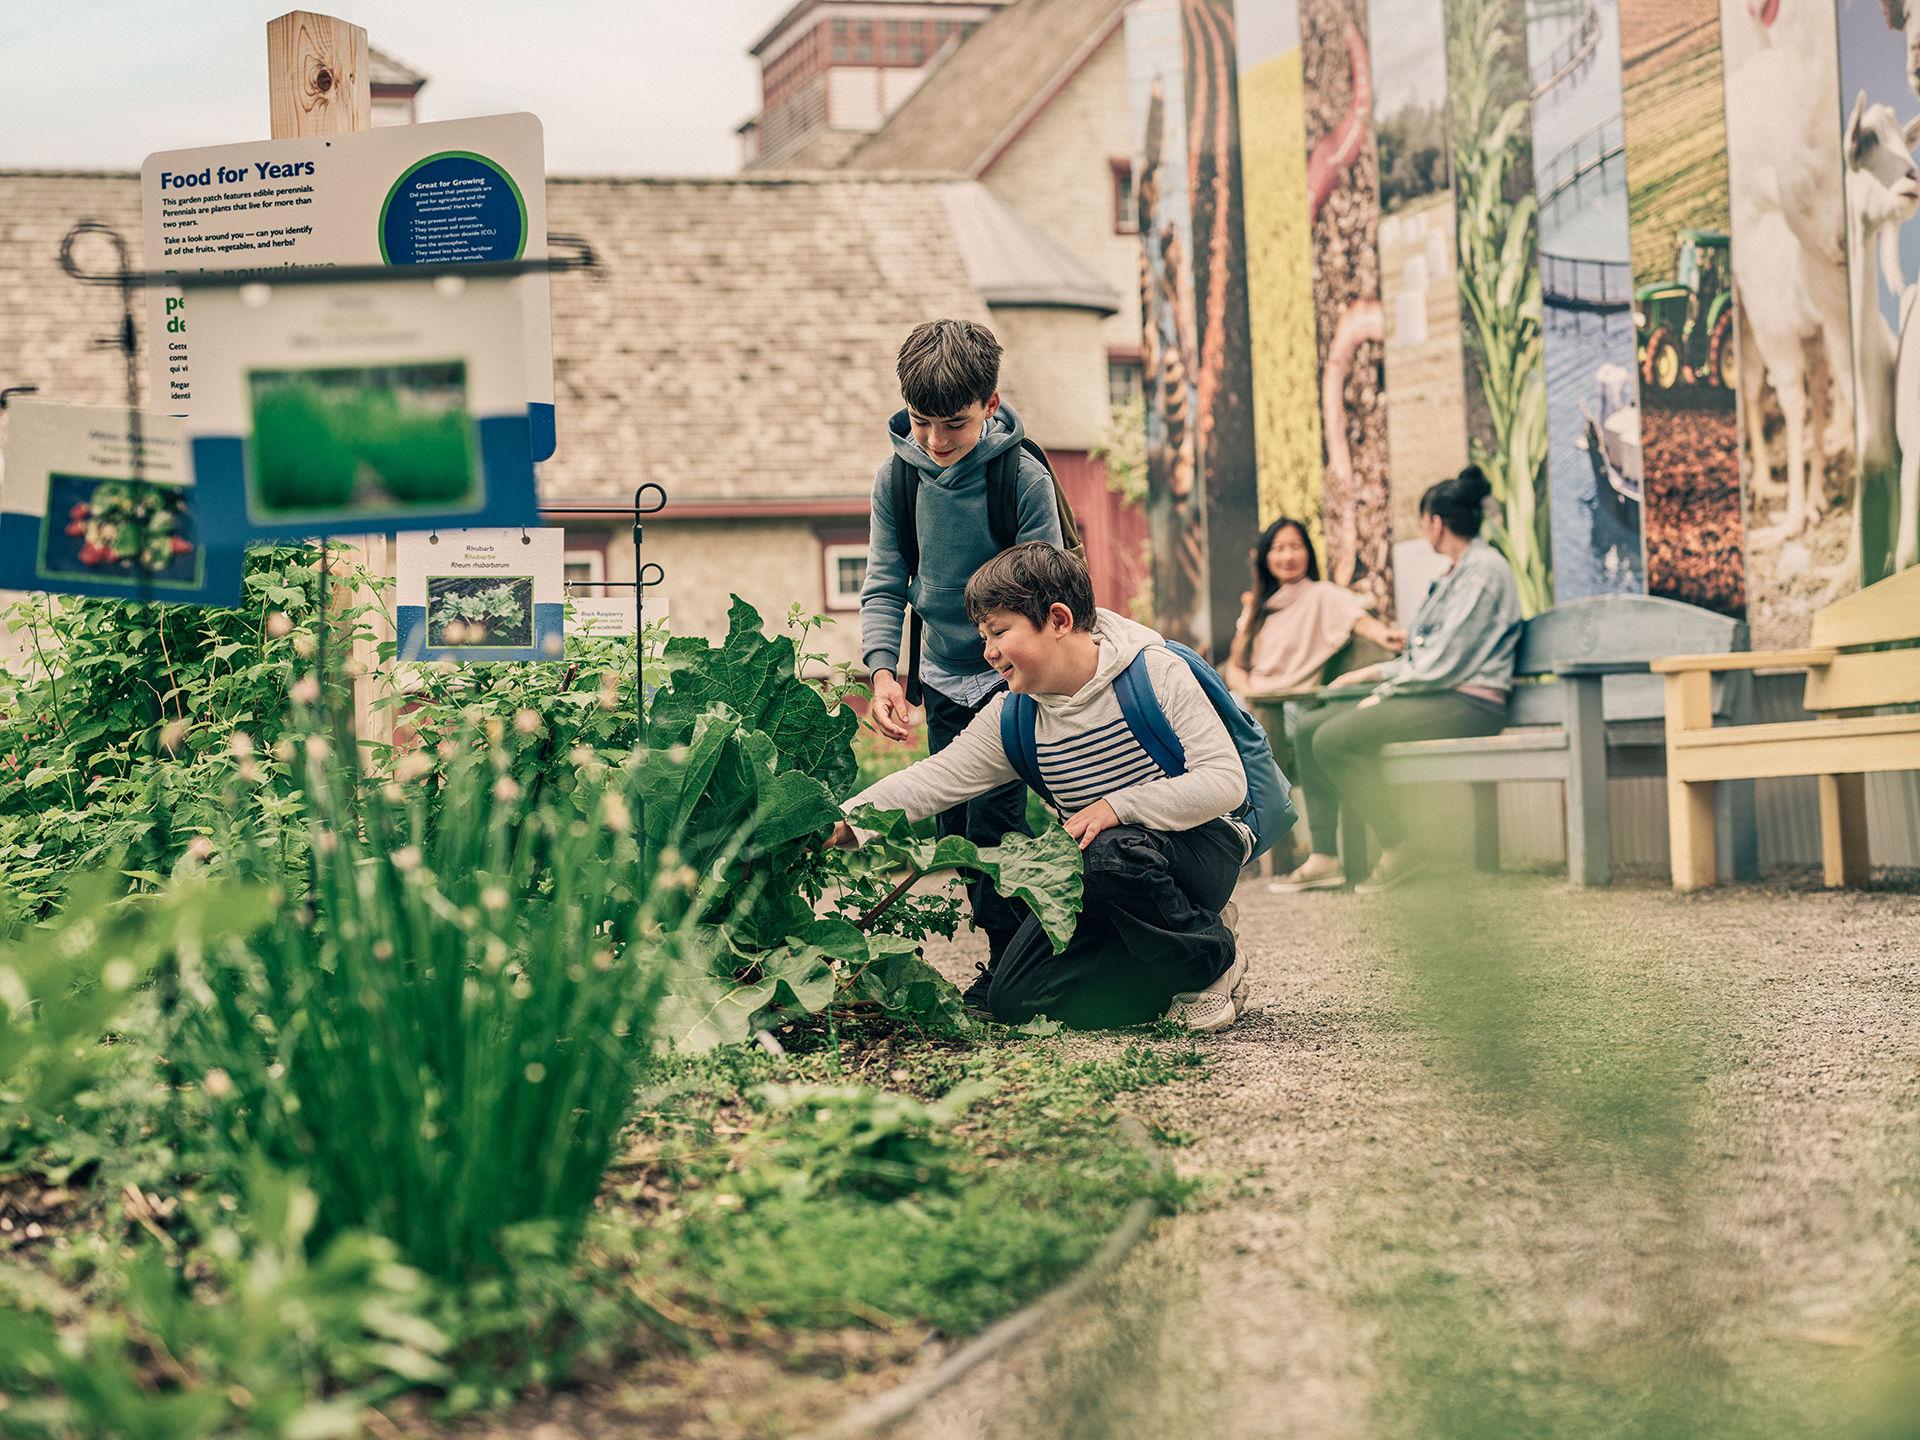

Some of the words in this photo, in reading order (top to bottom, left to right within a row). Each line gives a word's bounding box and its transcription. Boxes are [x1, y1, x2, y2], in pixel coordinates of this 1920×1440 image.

[161, 168, 211, 189] Food
[217, 166, 249, 184] for
[254, 161, 315, 180] Years
[452, 178, 485, 186] Growing
[162, 198, 177, 206] This
[178, 196, 202, 206] garden
[203, 194, 222, 204] patch
[223, 192, 252, 200] features
[253, 188, 274, 197] edible
[276, 185, 314, 197] perennials.
[162, 208, 196, 217] Perennials
[211, 205, 231, 214] plants
[233, 203, 247, 211] that
[262, 200, 273, 208] for
[295, 197, 312, 205] than
[178, 220, 198, 229] years.
[164, 236, 180, 244] Take
[188, 234, 203, 242] look
[205, 232, 229, 241] around
[231, 233, 244, 241] you
[270, 229, 283, 238] you
[285, 225, 313, 235] identify
[195, 245, 216, 253] fruits,
[217, 242, 255, 253] vegetables,
[257, 240, 271, 248] and
[272, 238, 296, 247] herbs?
[170, 365, 180, 374] qui
